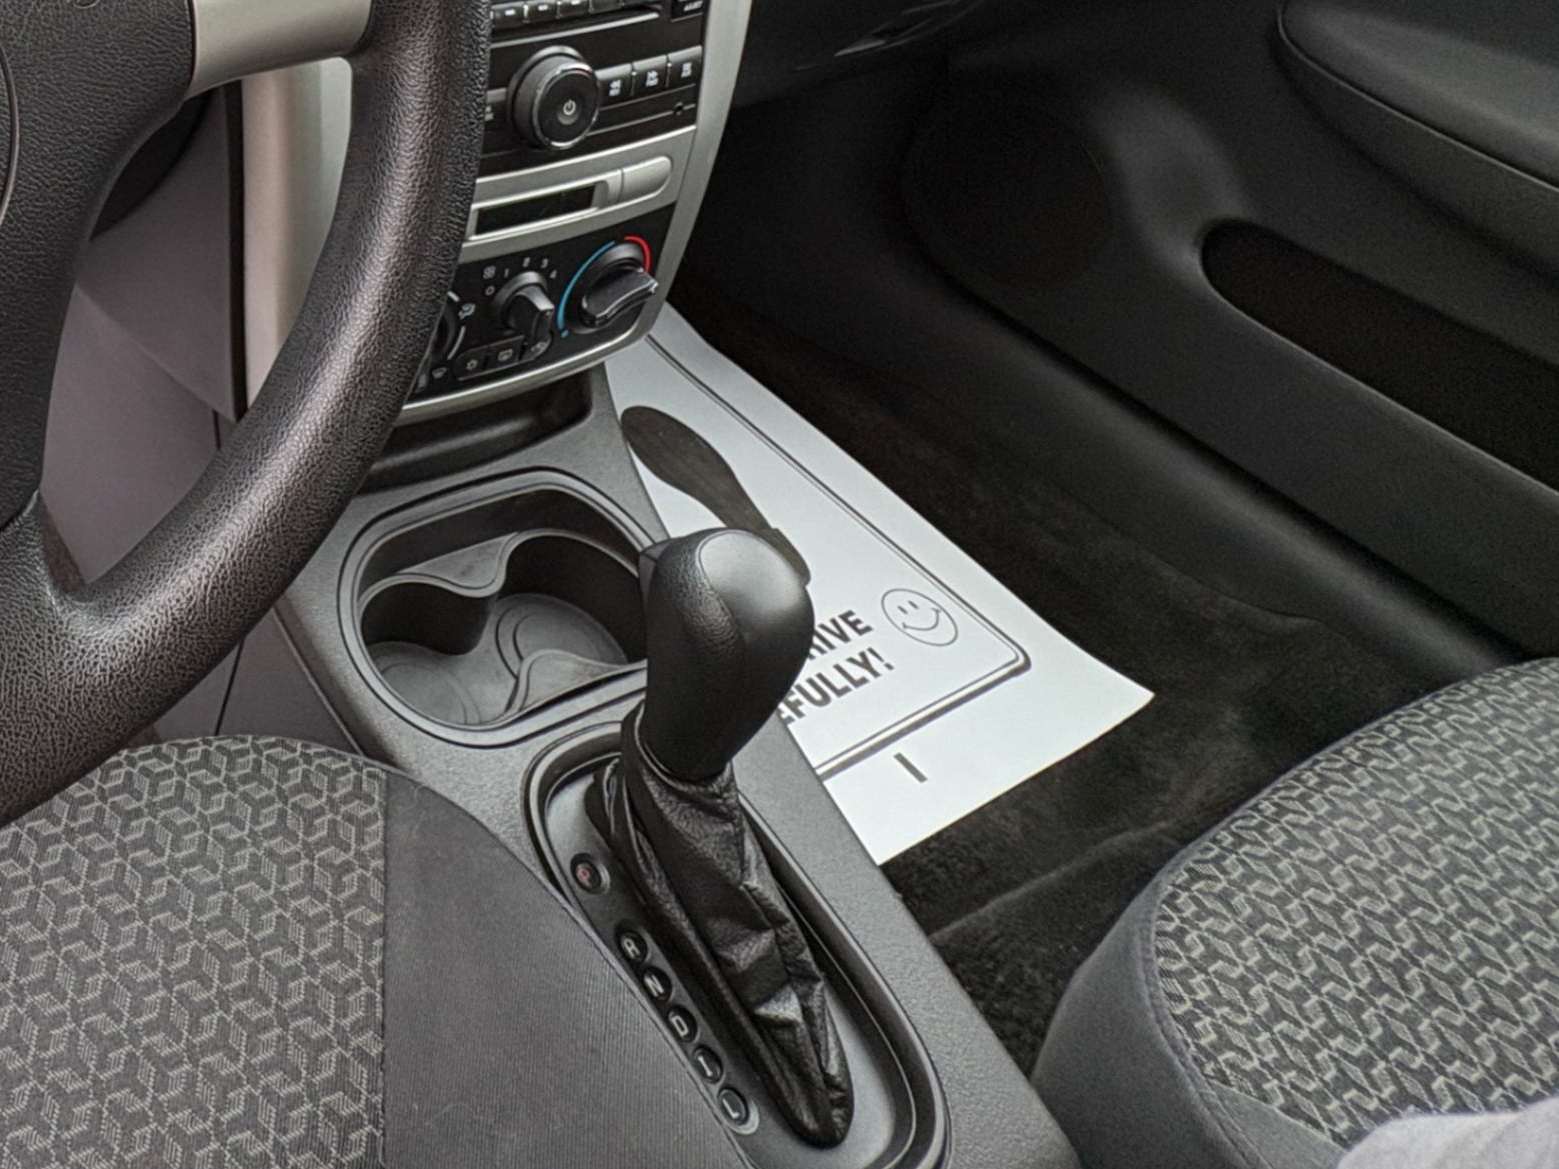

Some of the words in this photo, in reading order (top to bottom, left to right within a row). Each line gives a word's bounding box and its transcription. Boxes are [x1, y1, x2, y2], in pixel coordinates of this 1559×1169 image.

[621, 937, 641, 958] R
[644, 975, 665, 997] N
[668, 1009, 689, 1037] D
[723, 1098, 739, 1119] L
